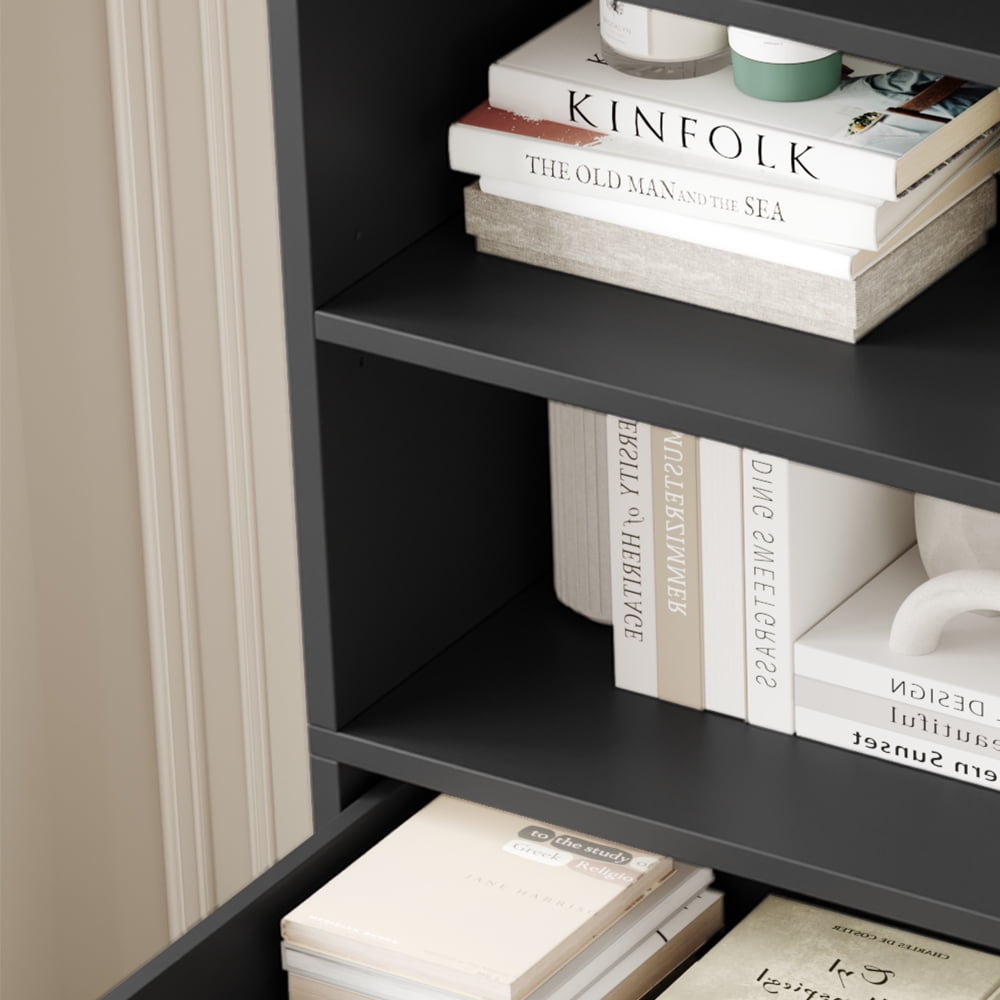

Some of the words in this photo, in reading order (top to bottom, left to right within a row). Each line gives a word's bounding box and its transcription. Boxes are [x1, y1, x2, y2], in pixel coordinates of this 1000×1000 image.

[568, 89, 820, 181] KINFOLK
[526, 154, 571, 181] THE
[576, 164, 622, 190] OLD
[627, 175, 676, 201] MAN
[677, 189, 707, 207] AND
[710, 194, 738, 212] THE
[744, 196, 785, 223] SEA
[512, 842, 563, 863] Greek
[530, 829, 549, 840] to
[555, 836, 583, 850] the
[584, 844, 630, 864] study
